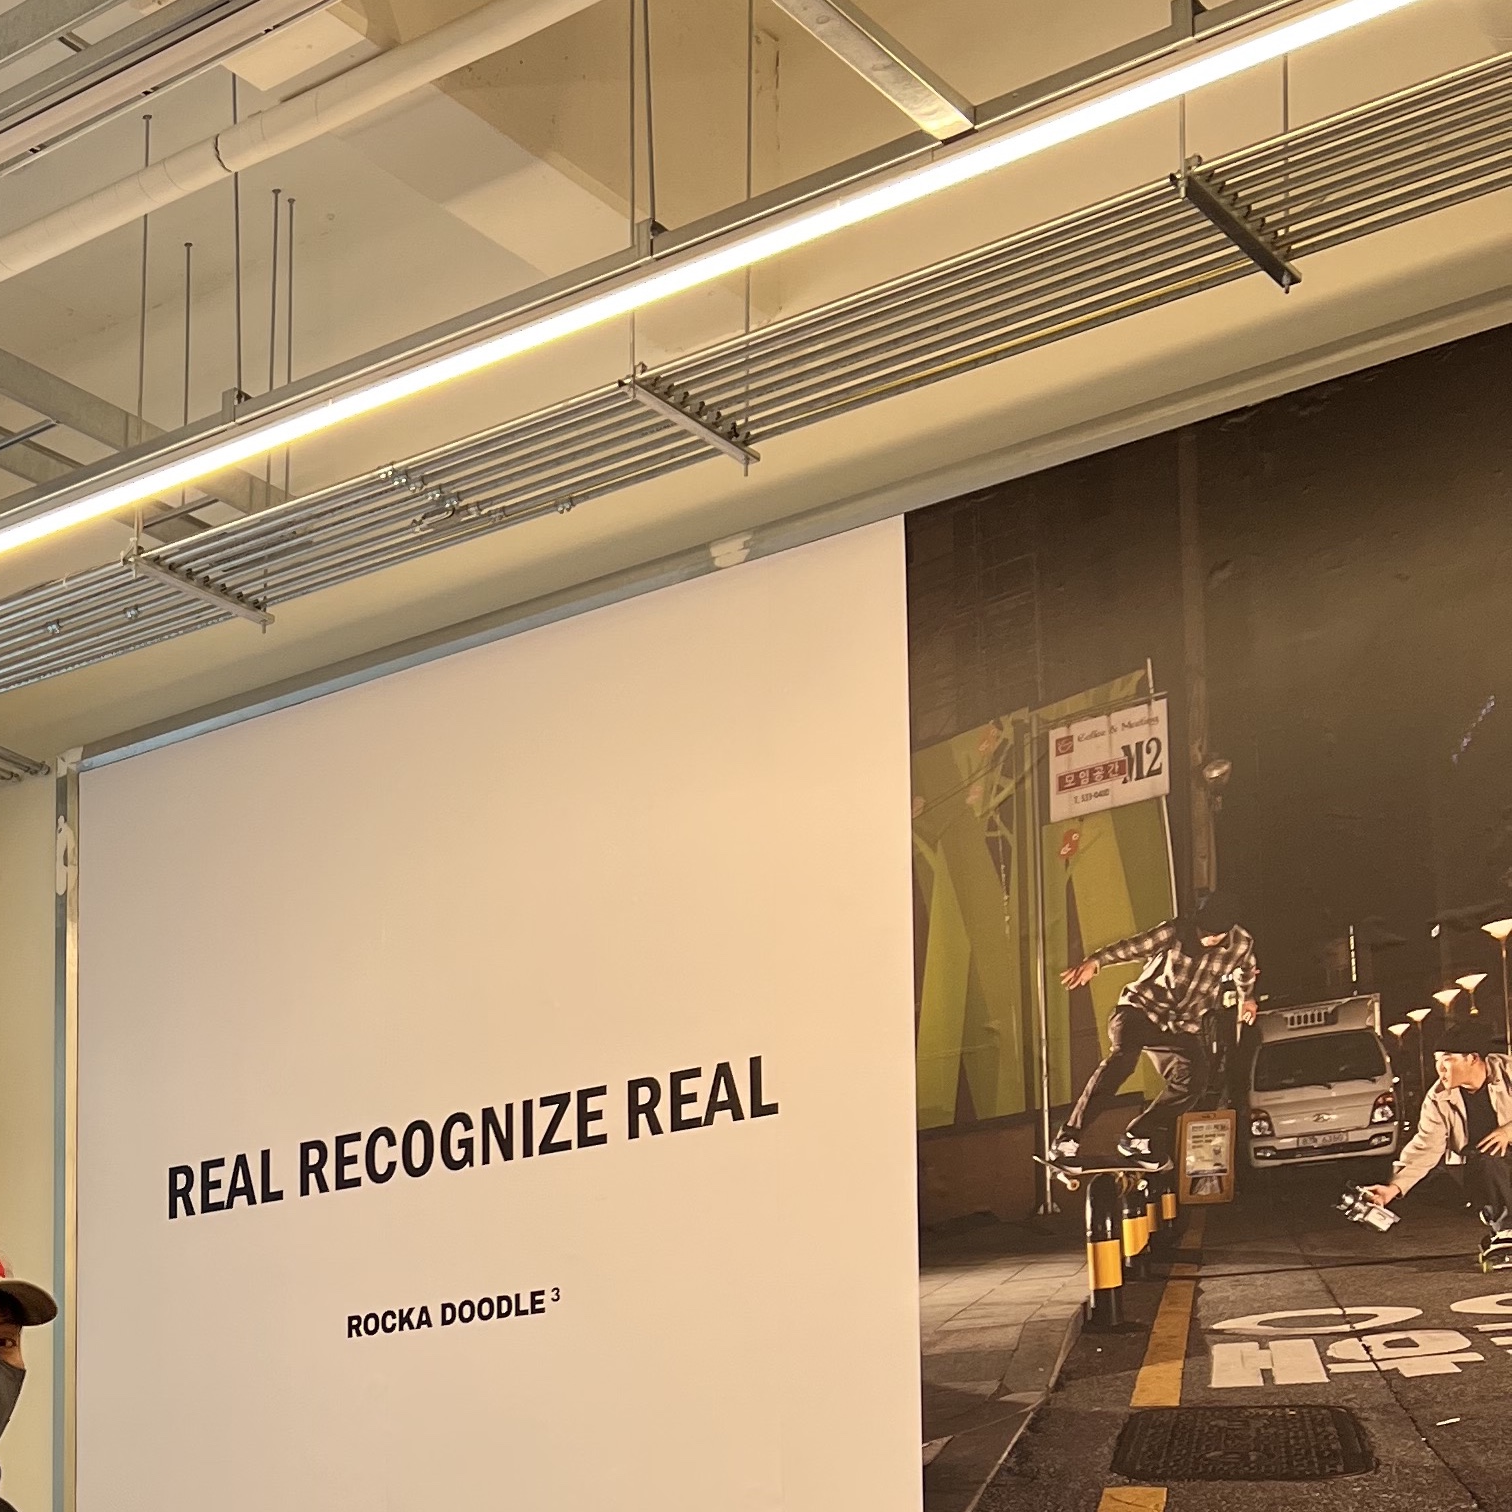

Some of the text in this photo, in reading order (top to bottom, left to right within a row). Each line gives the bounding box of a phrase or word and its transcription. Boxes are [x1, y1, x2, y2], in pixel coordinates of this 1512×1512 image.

[1063, 761, 1120, 788] 모임공간
[168, 1056, 779, 1220] REAL RECOGNIZE REAL
[347, 1306, 433, 1338] ROCKA
[441, 1290, 546, 1327] DOODLE
